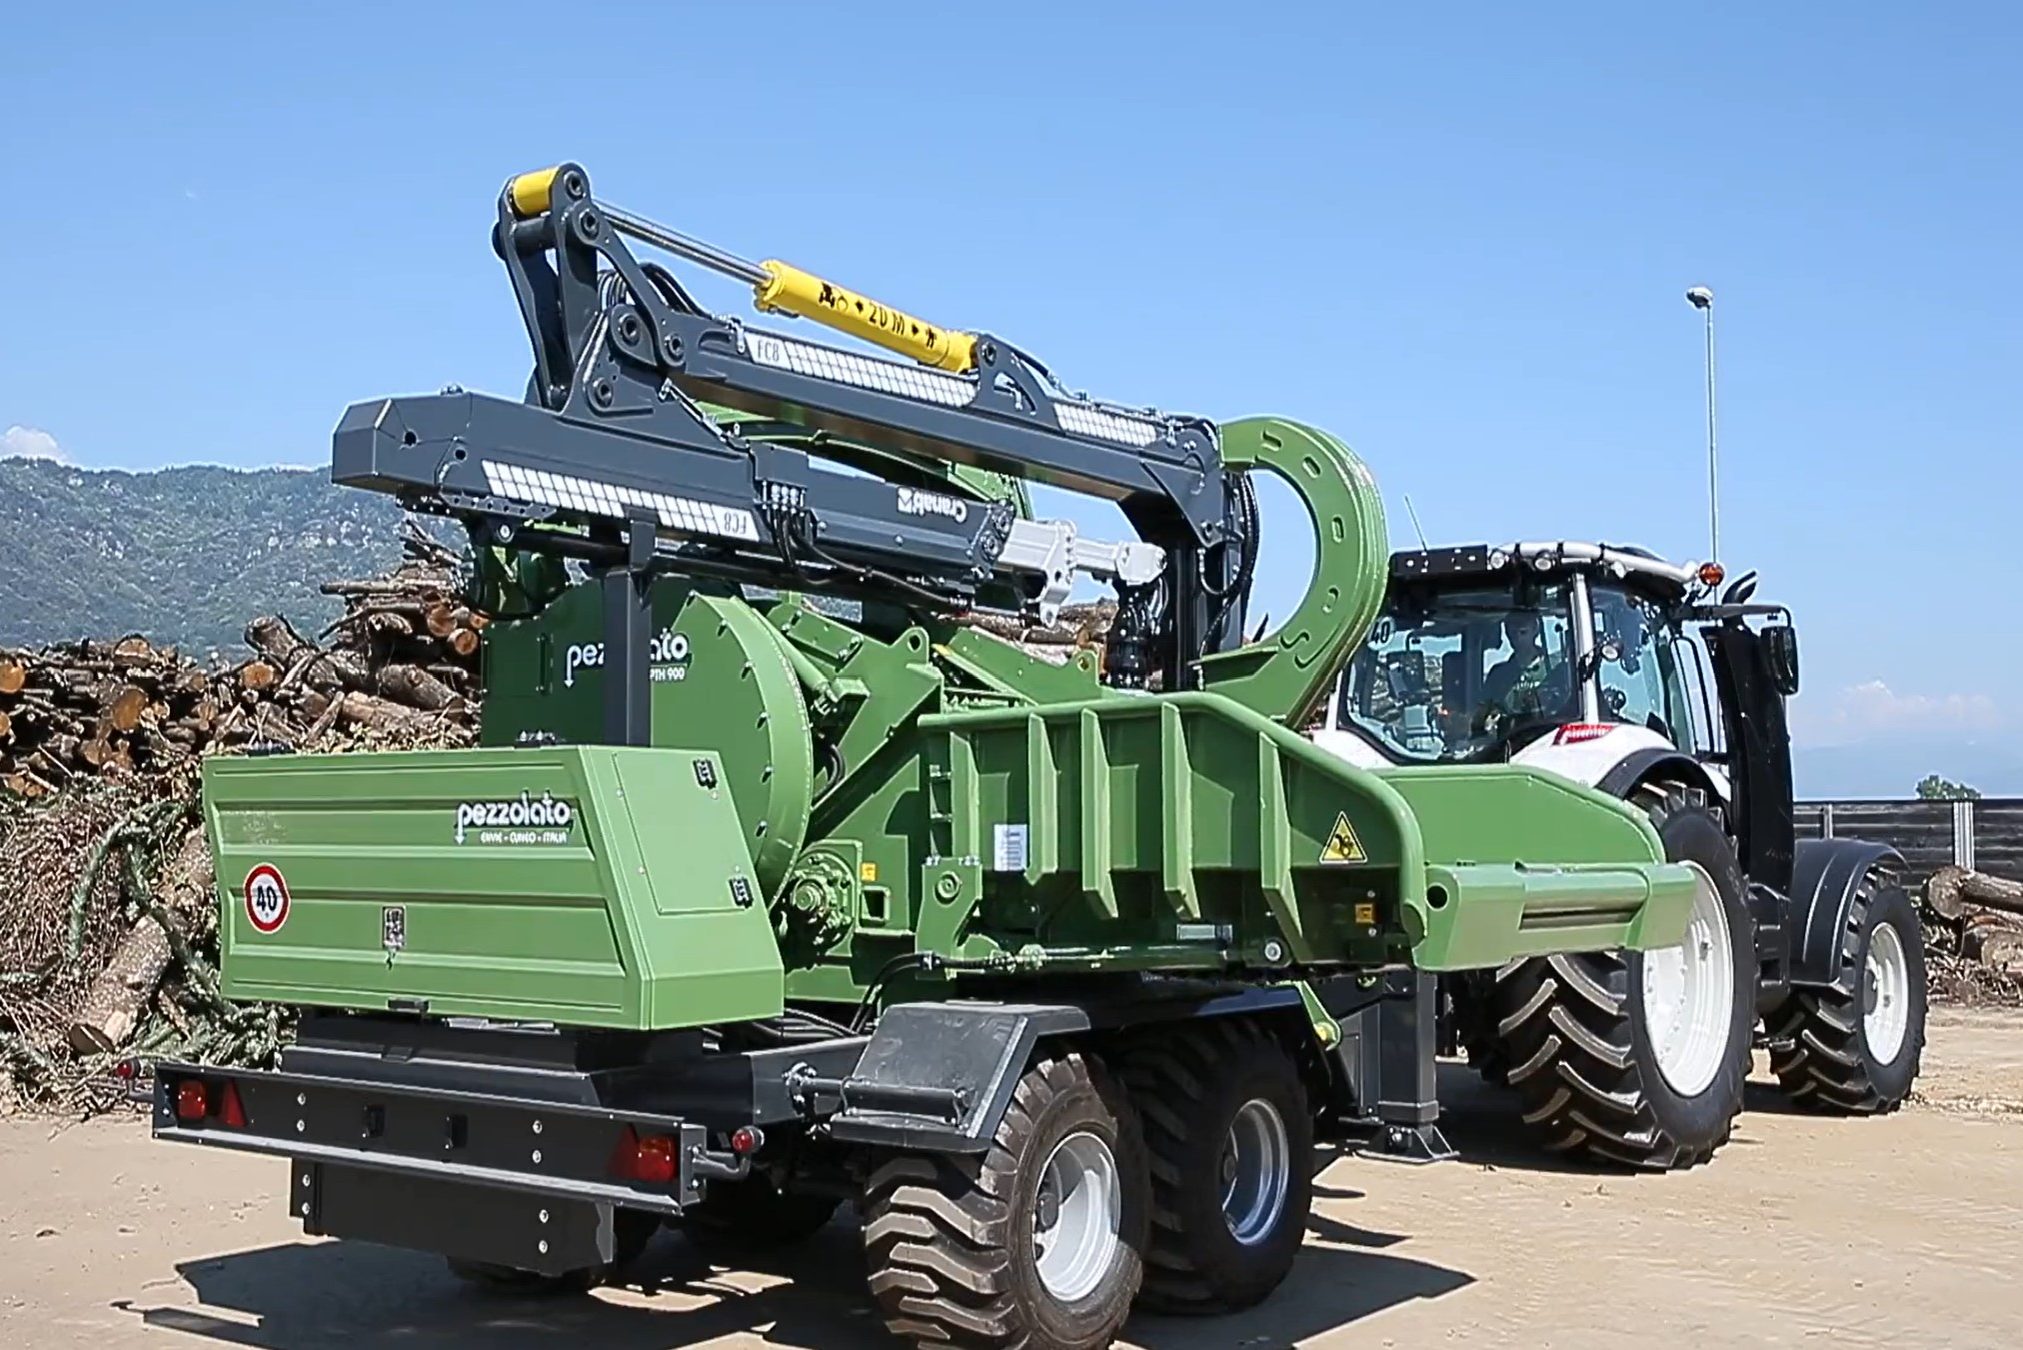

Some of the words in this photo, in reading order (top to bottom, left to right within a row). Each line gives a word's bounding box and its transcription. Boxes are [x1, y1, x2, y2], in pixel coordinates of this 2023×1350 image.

[868, 301, 888, 327] 20
[757, 339, 780, 362] FC8
[912, 490, 968, 524] Cranab
[723, 511, 748, 535] FC8
[1370, 620, 1391, 645] 40
[667, 666, 685, 680] 900
[454, 790, 571, 845] pezzolato
[256, 885, 278, 912] 40
